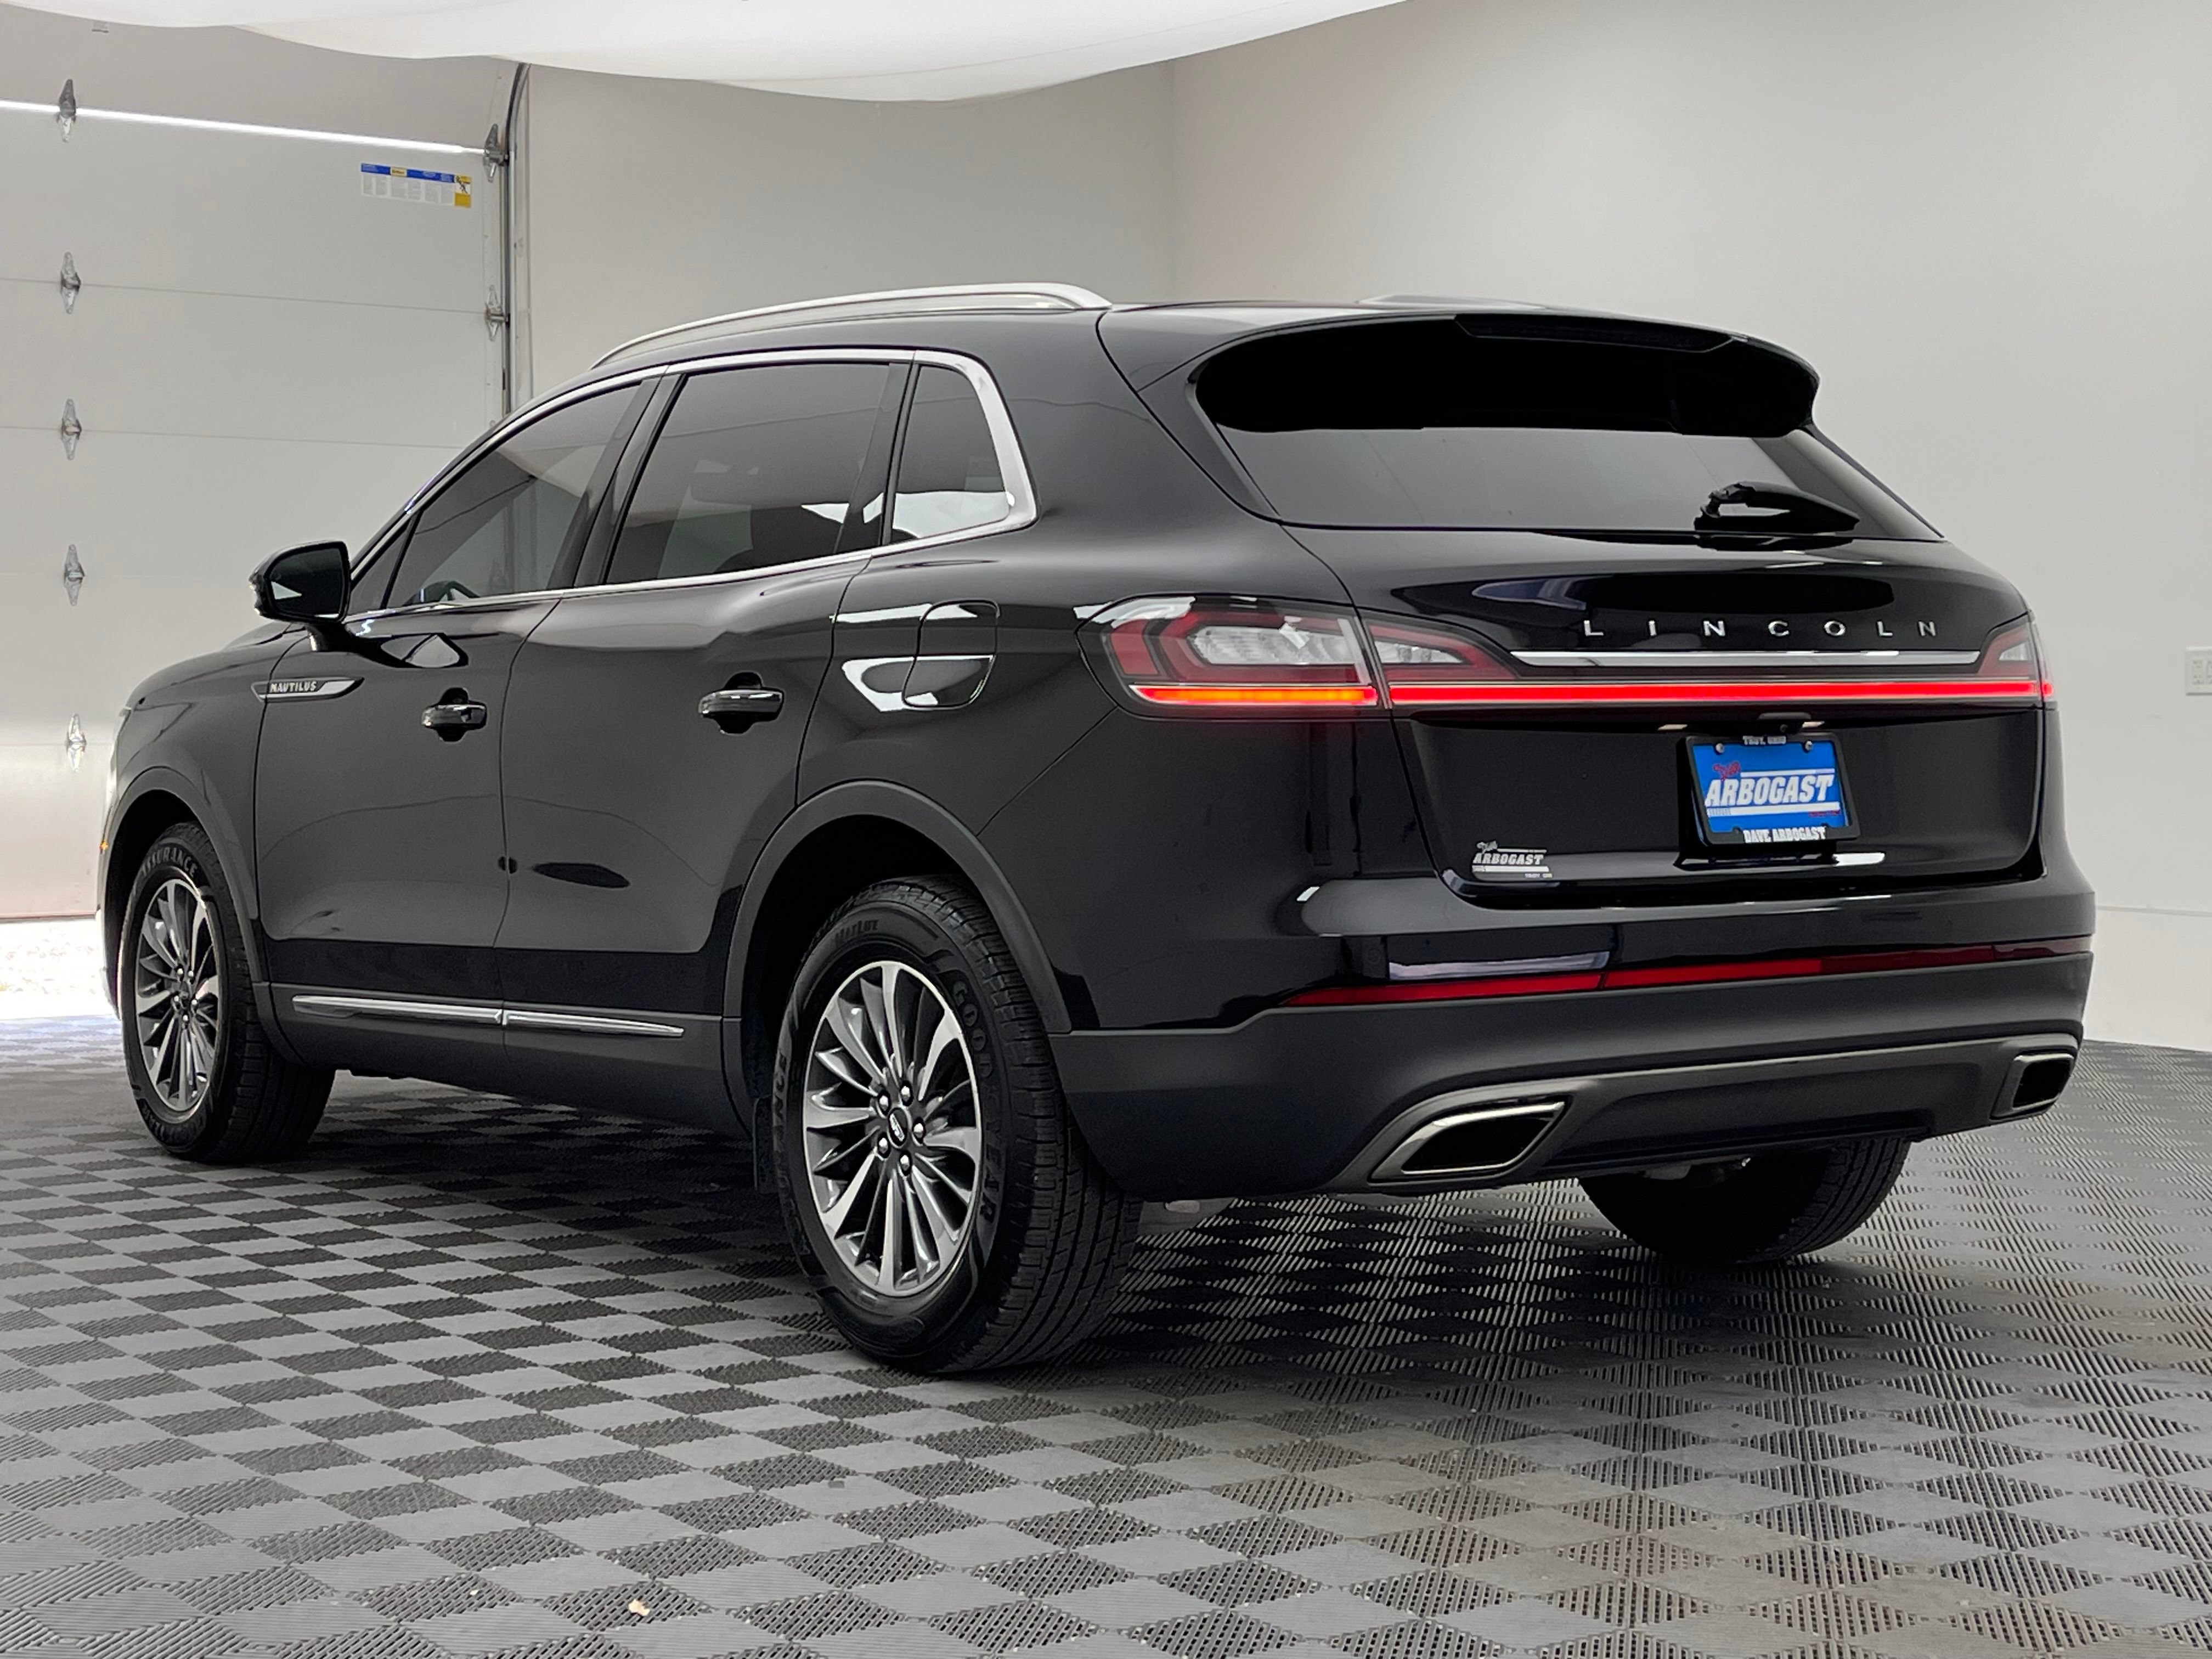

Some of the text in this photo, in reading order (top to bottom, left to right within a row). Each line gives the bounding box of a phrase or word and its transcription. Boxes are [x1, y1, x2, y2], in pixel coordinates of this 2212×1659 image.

[1583, 619, 1937, 637] LINCOLN
[269, 681, 318, 693] NAUTILUS
[1705, 775, 1835, 806] ARBOGAST
[1743, 826, 1826, 843] DAVE ARBOGAST
[141, 847, 198, 877] ASSURANCE
[1472, 853, 1544, 865] ARBOGAST
